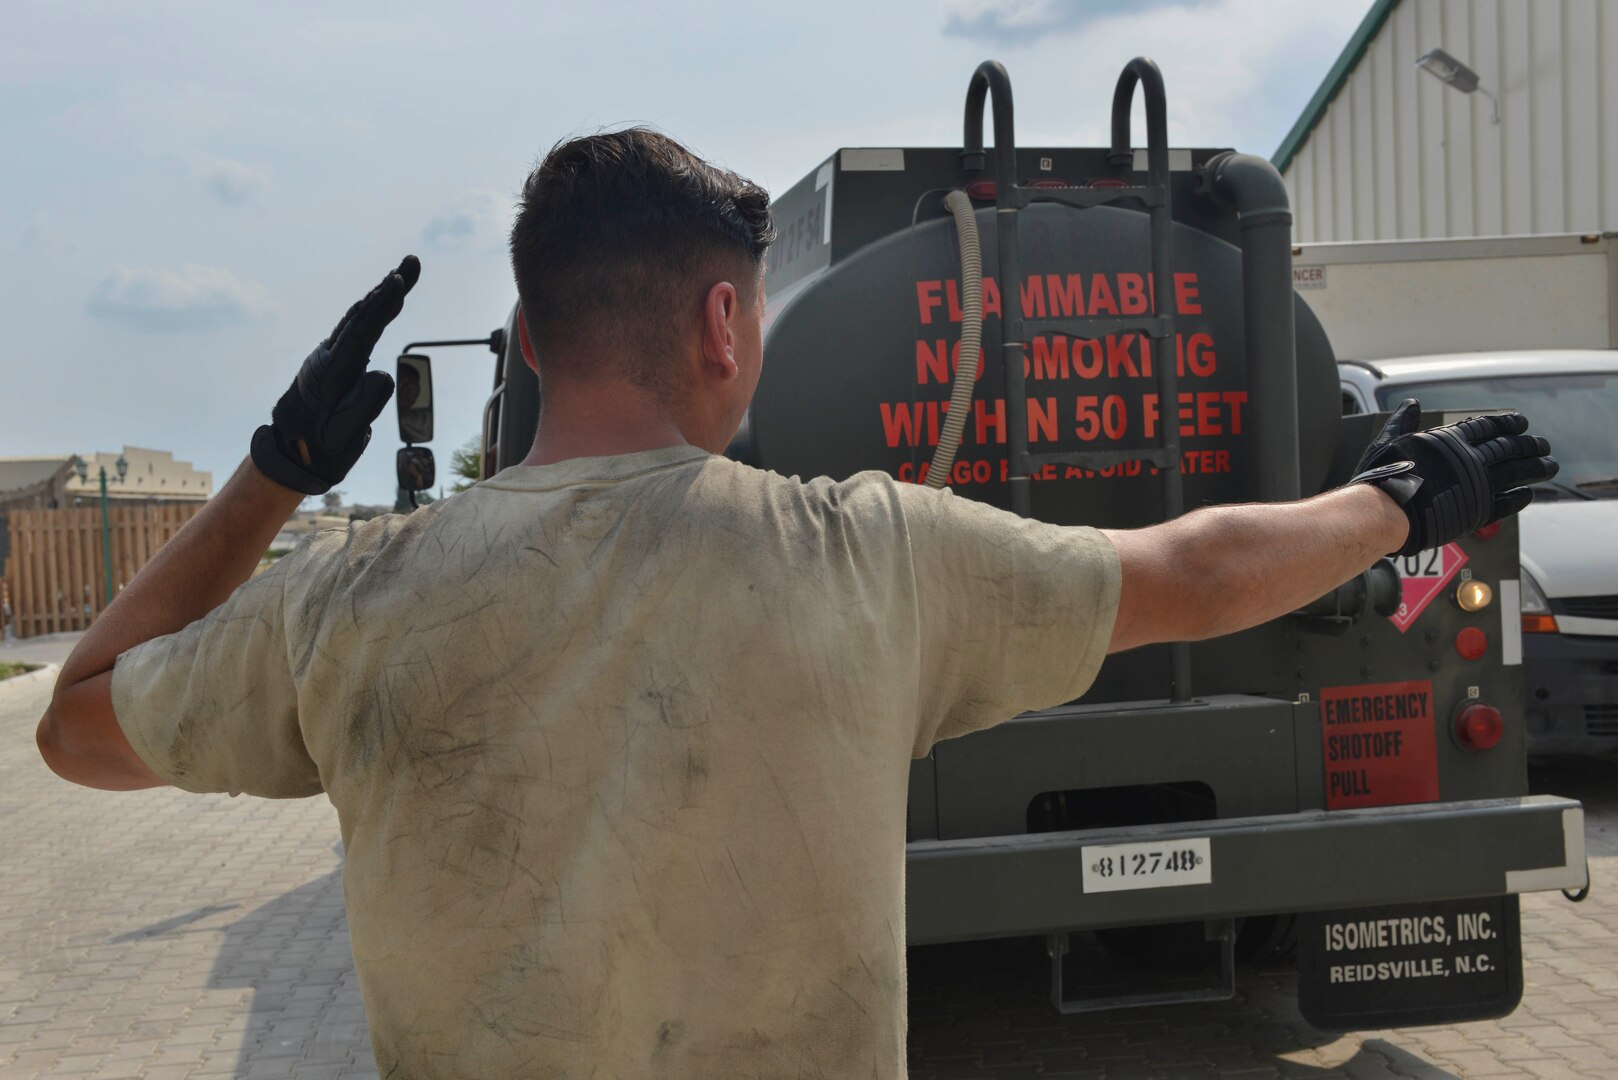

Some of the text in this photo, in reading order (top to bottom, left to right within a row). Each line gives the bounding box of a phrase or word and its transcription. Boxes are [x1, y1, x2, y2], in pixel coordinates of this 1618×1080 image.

[1023, 333, 1217, 381] MOKIG
[880, 397, 1059, 448] WIHN
[1075, 394, 1127, 441] 50
[898, 459, 991, 485] CAGO
[1151, 450, 1231, 476] TER
[1392, 546, 1439, 577] 02
[1399, 603, 1408, 617] 3
[1325, 692, 1428, 725] EMERGENCY
[1330, 768, 1371, 797] PULL
[1100, 850, 1195, 878] 812748
[1325, 912, 1497, 951] ISOMETRICS, INC.
[1330, 954, 1495, 983] REIDSVILLE, N.C.
